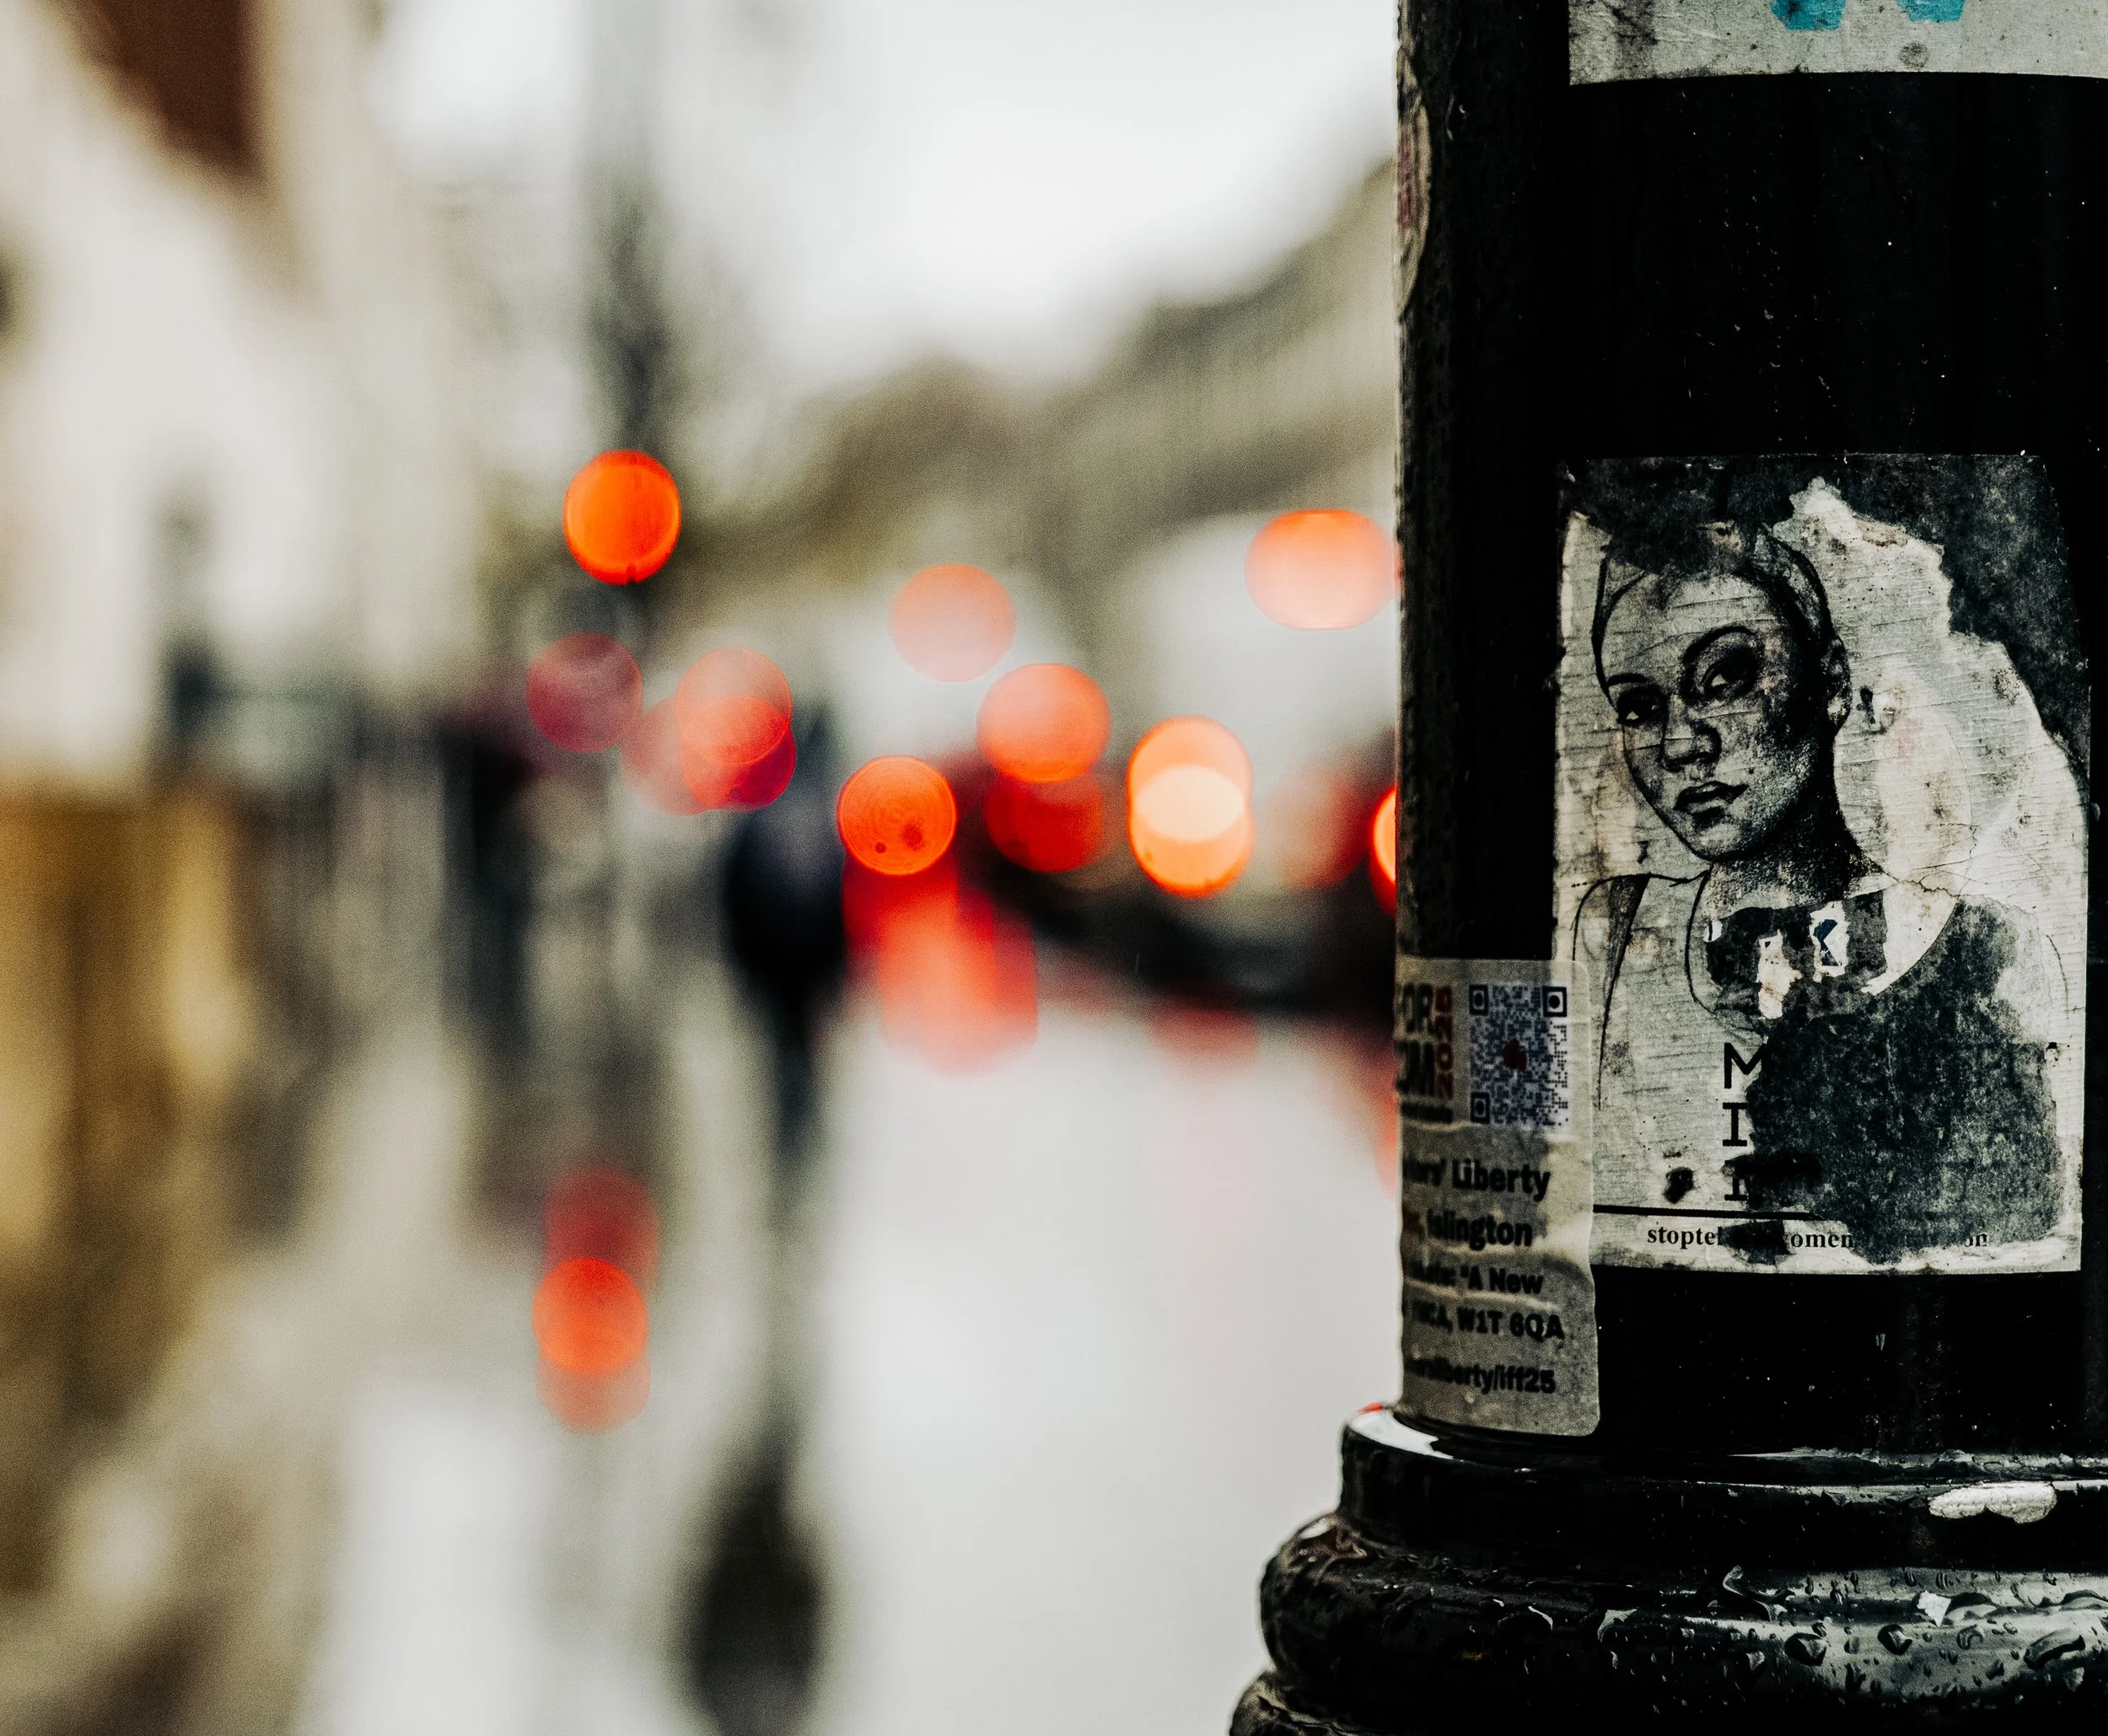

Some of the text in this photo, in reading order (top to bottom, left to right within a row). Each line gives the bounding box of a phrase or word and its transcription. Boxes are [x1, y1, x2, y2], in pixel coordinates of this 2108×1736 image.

[1453, 1158, 1551, 1201] Liberty
[1786, 1232, 1854, 1249] omen
[1489, 1268, 1544, 1294] New
[1509, 1313, 1565, 1342] 6QA
